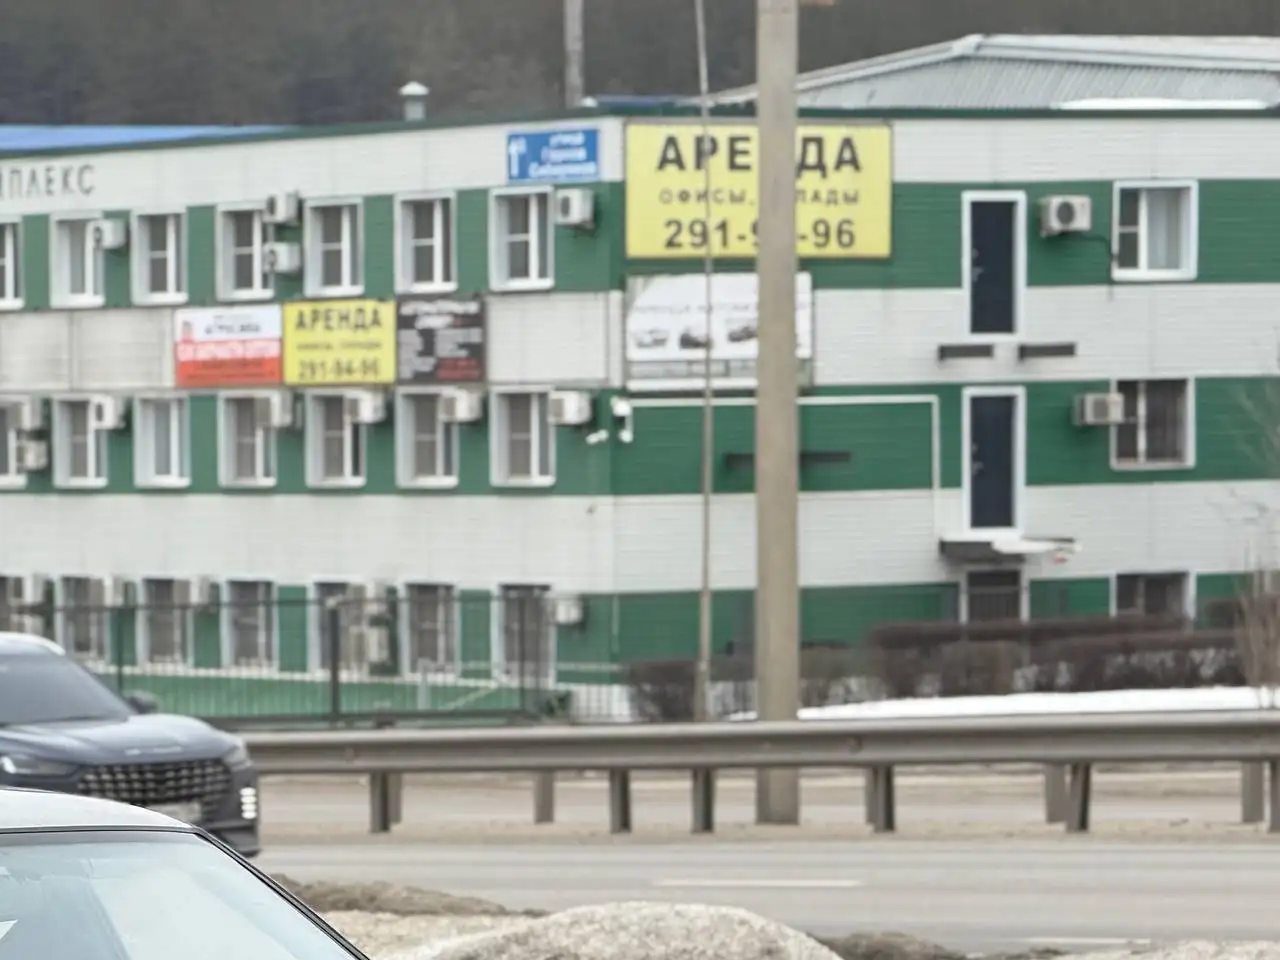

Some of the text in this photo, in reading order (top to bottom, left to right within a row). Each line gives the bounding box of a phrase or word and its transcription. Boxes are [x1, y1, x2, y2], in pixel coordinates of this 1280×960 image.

[656, 134, 862, 179] АРЕДА
[663, 218, 856, 250] 291--96
[296, 307, 382, 333] АРЕНДА
